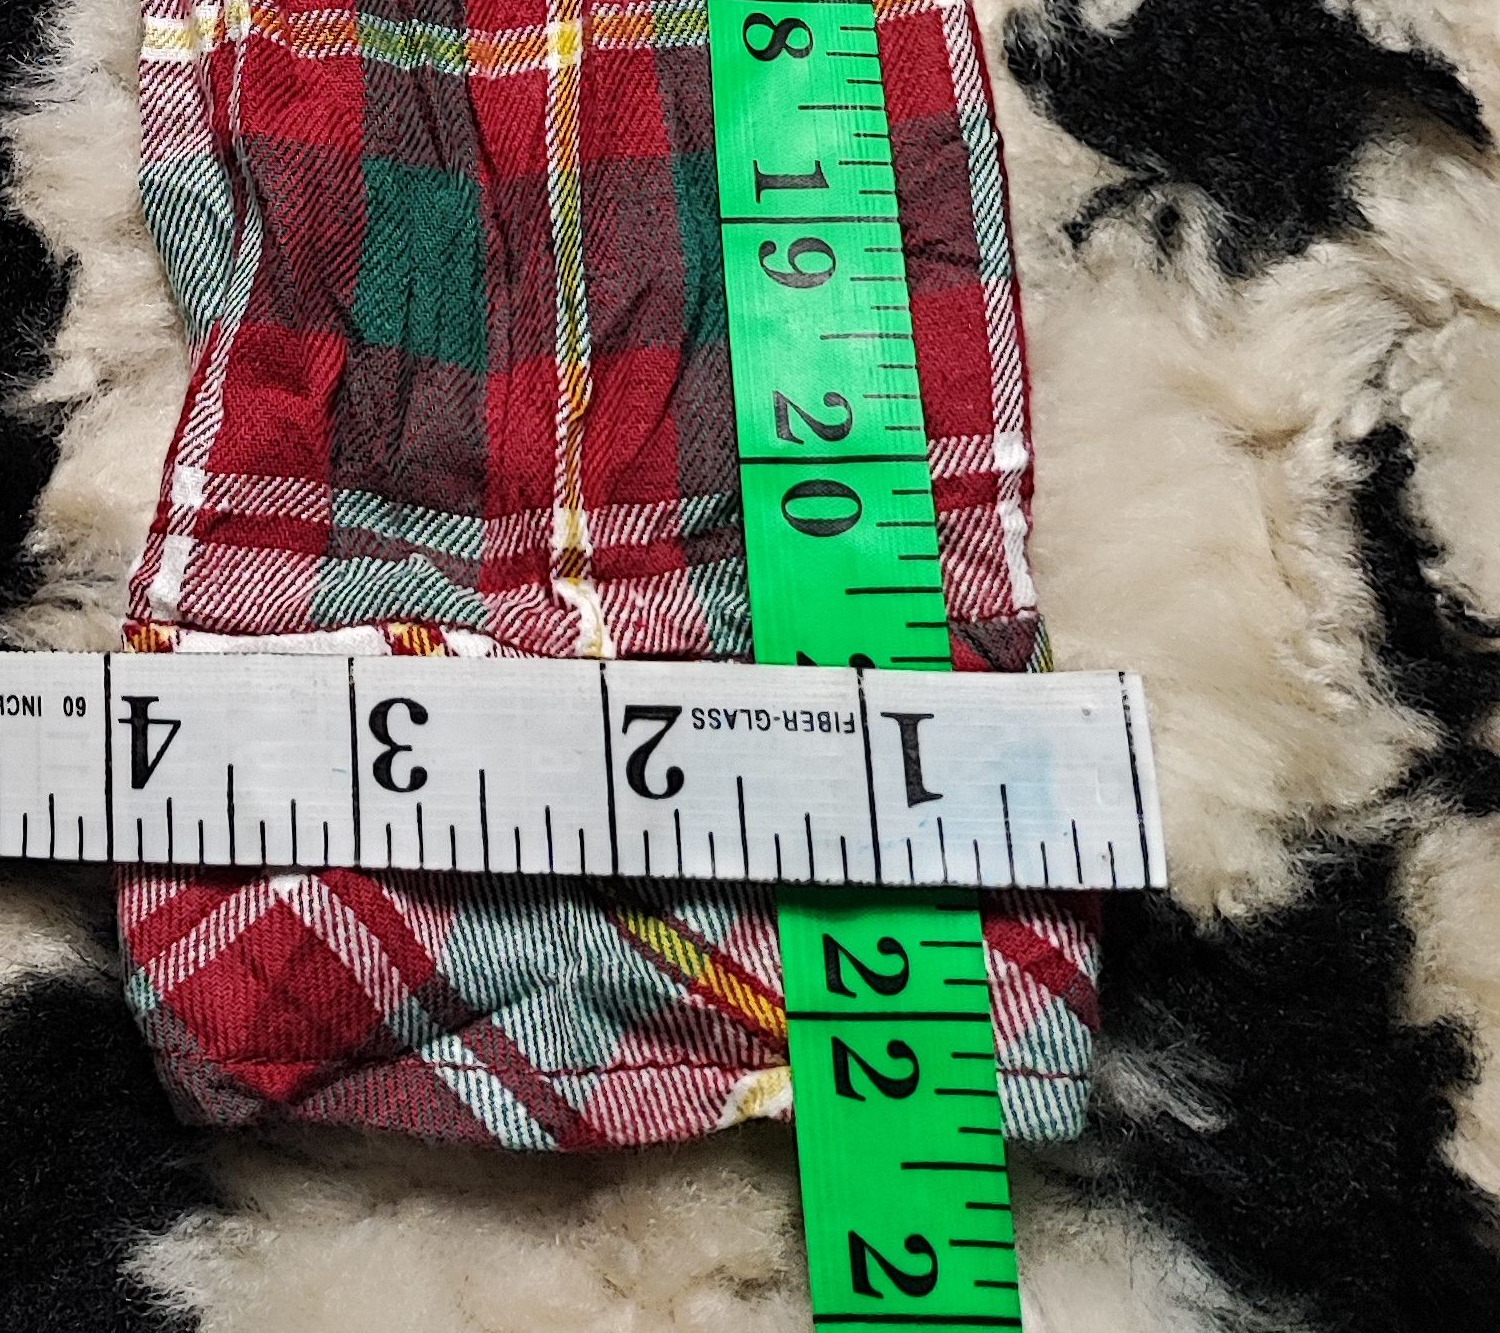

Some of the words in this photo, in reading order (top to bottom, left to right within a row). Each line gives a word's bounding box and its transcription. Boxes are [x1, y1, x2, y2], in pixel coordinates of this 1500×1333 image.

[752, 159, 837, 290] 19
[772, 389, 863, 538] 20
[63, 695, 87, 719] 60
[118, 695, 182, 790] 4
[367, 697, 430, 793] 3
[621, 704, 686, 800] 2
[690, 707, 856, 734] FIBER-GLASS
[880, 711, 944, 808] 1
[822, 933, 920, 1101] 22
[847, 1229, 940, 1299] 2
